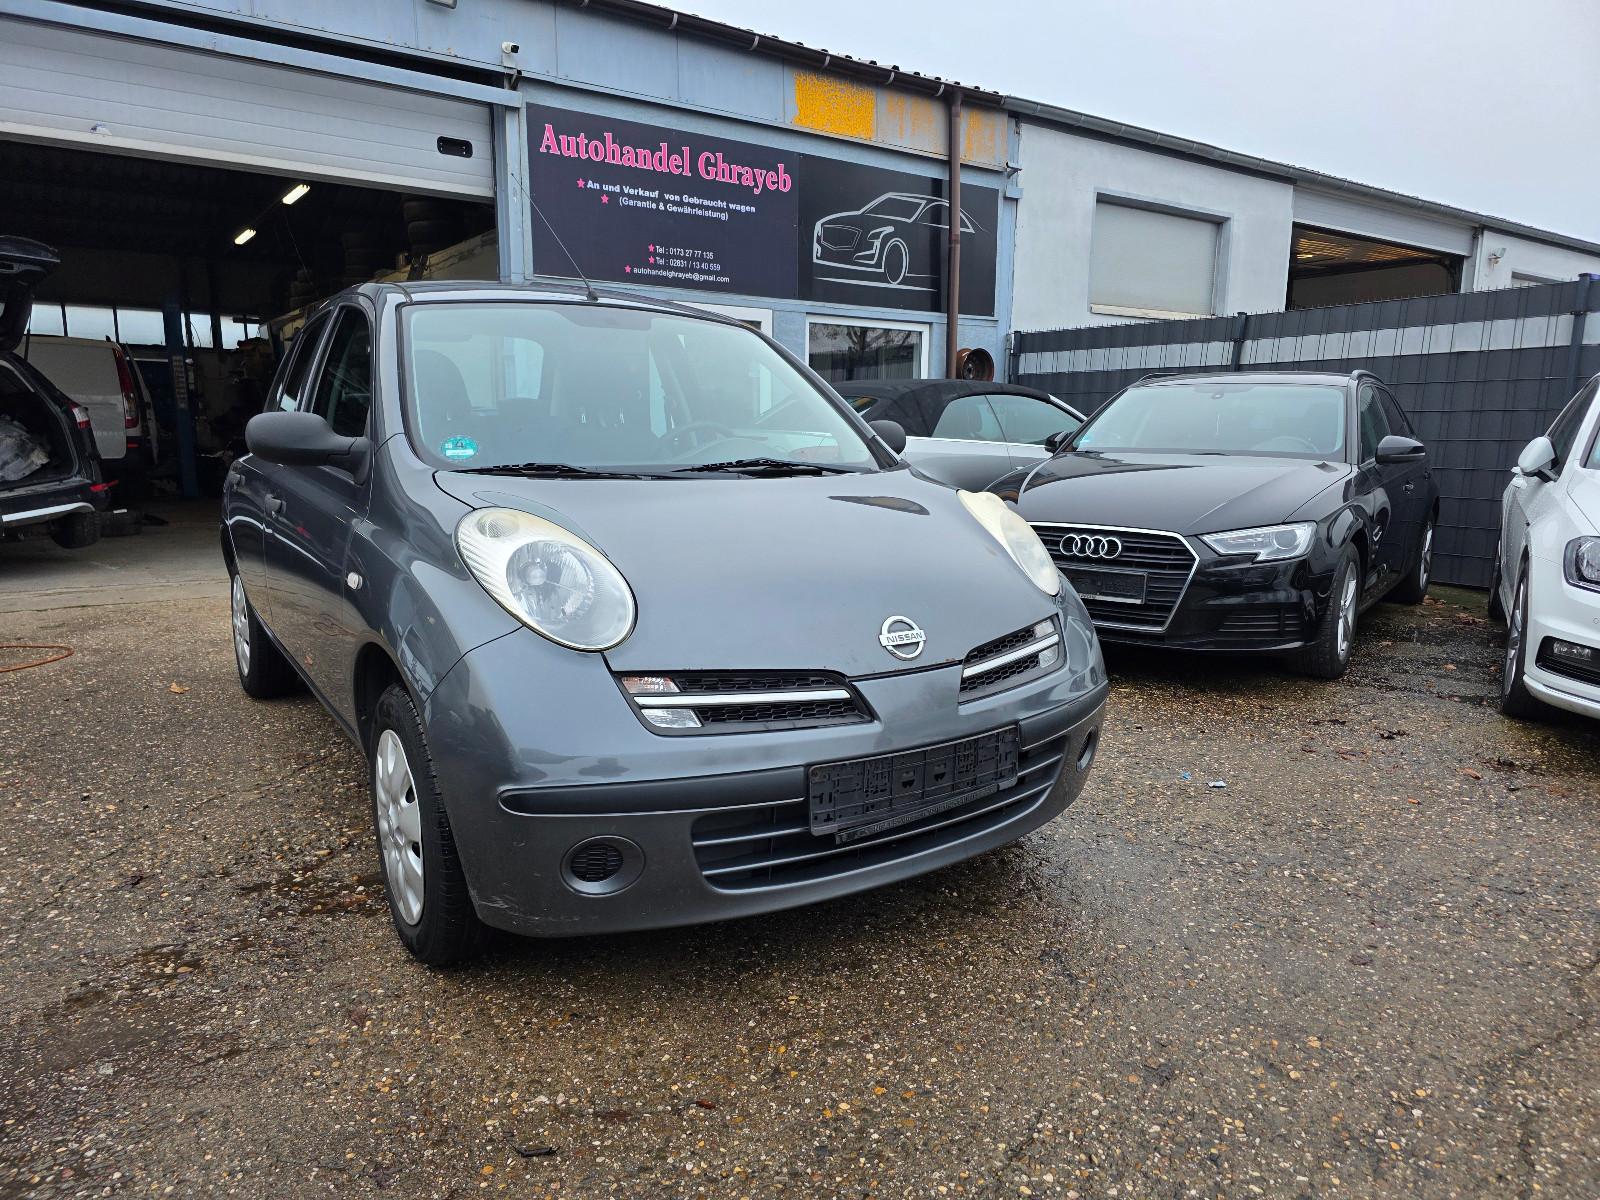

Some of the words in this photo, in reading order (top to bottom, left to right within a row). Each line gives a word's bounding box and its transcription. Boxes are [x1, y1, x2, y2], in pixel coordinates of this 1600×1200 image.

[540, 123, 692, 177] Autohandel
[698, 151, 792, 195] Ghrayeb
[587, 180, 600, 190] An
[603, 183, 620, 193] und
[622, 186, 659, 199] Verkauf
[664, 193, 680, 202] von
[682, 194, 727, 209] Gebraucht
[729, 202, 756, 213] wagen
[619, 196, 657, 210] (Garantie
[658, 202, 665, 211] &
[666, 203, 729, 221] Gewährleistung)
[656, 246, 665, 254] Tel
[669, 247, 684, 256] 0173
[685, 249, 693, 257] 27
[694, 250, 701, 258] 77
[656, 257, 665, 265] Tel
[669, 258, 687, 267] 02831
[693, 261, 700, 269] 13
[701, 262, 708, 270] 40
[886, 632, 923, 643] NISSAN
